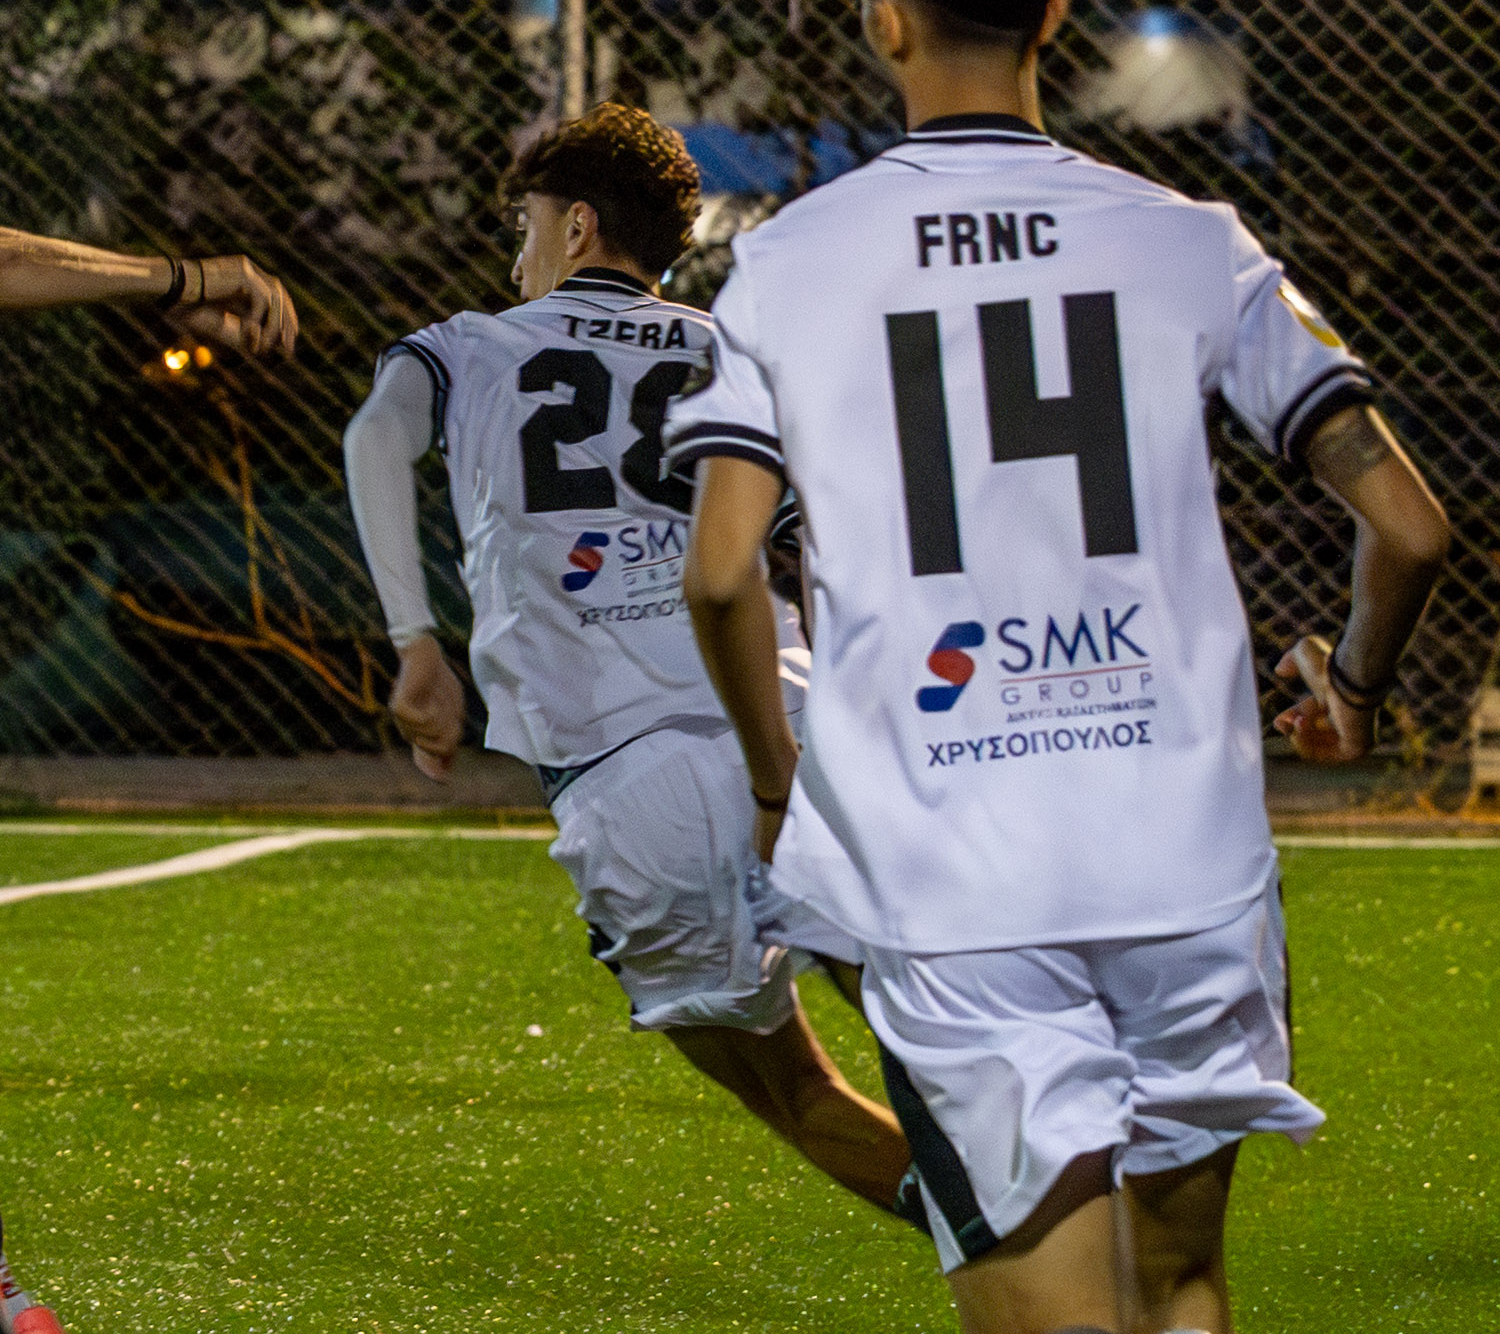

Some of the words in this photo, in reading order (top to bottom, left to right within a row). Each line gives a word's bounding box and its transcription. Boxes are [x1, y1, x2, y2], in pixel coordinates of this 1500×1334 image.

[914, 212, 1059, 267] FRNC
[885, 291, 1138, 577] 14
[618, 519, 691, 563] SM
[998, 603, 1148, 673] SMK
[1000, 671, 1153, 706] GROUP
[926, 720, 1153, 767] ΧΡΥΣΟΠΟΥΛΟΣ
